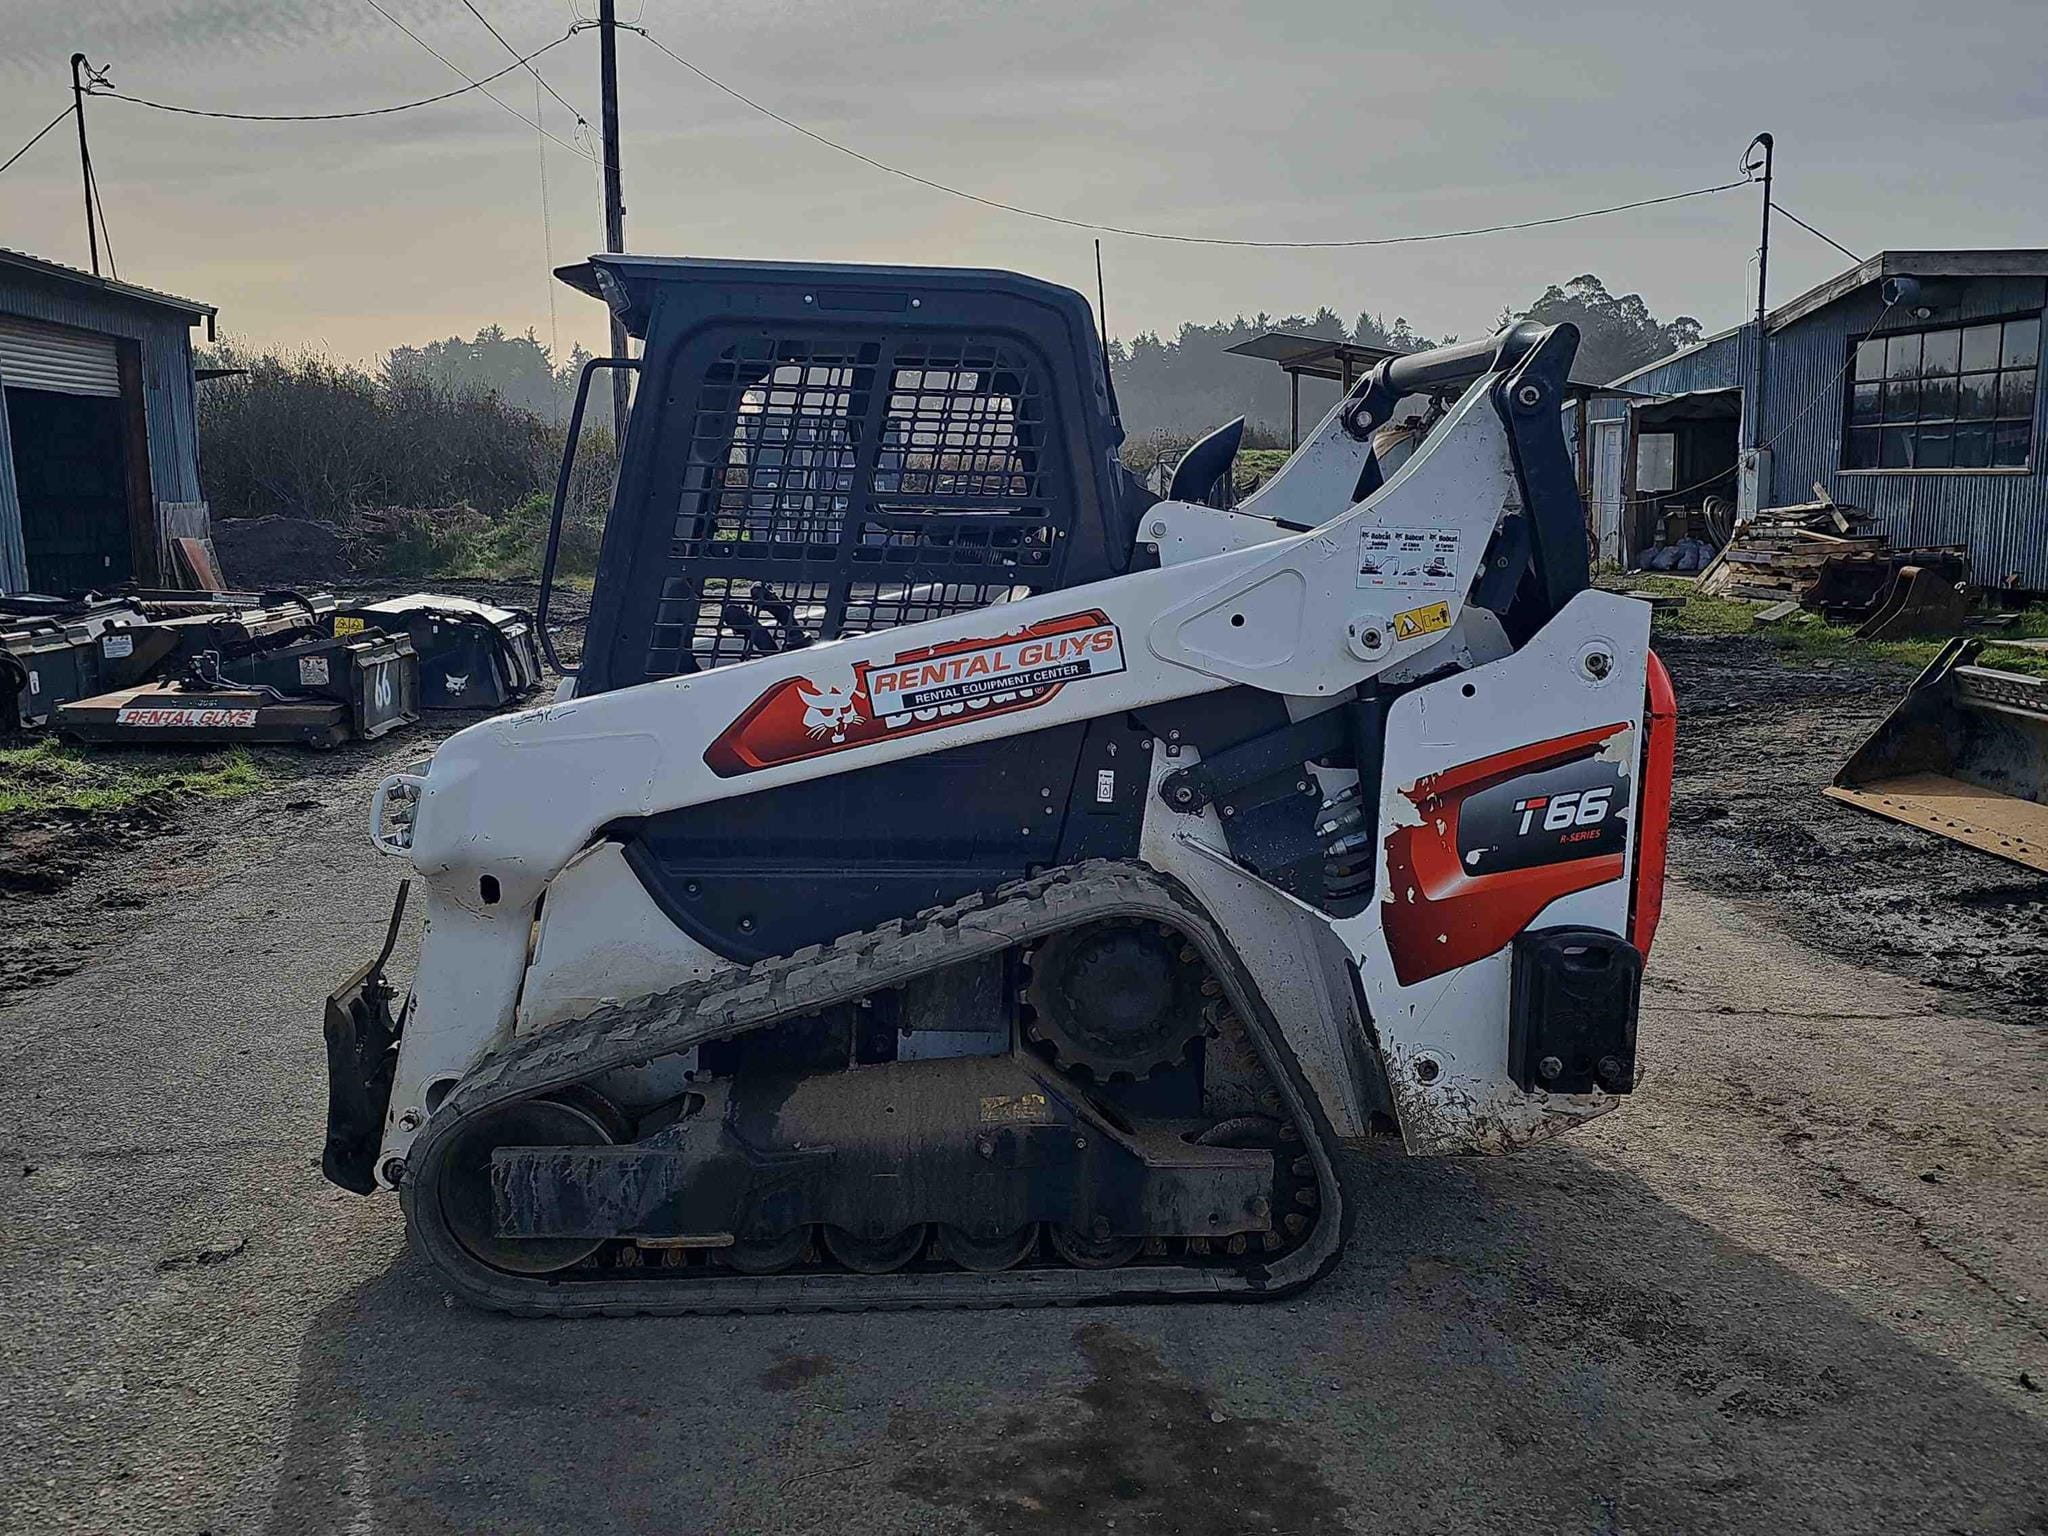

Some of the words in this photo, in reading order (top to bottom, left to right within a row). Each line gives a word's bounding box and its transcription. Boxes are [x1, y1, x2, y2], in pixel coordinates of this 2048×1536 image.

[874, 651, 1011, 695] RENTAL
[1018, 630, 1114, 667] GUYS
[914, 686, 961, 704] RENTAL
[962, 674, 1031, 694] EQUIPMENT
[1033, 665, 1079, 682] CENTER
[125, 710, 193, 725] RENTAL
[200, 710, 252, 725] GUYS
[1514, 786, 1613, 836] T66
[1559, 829, 1601, 844] R-SERIES
